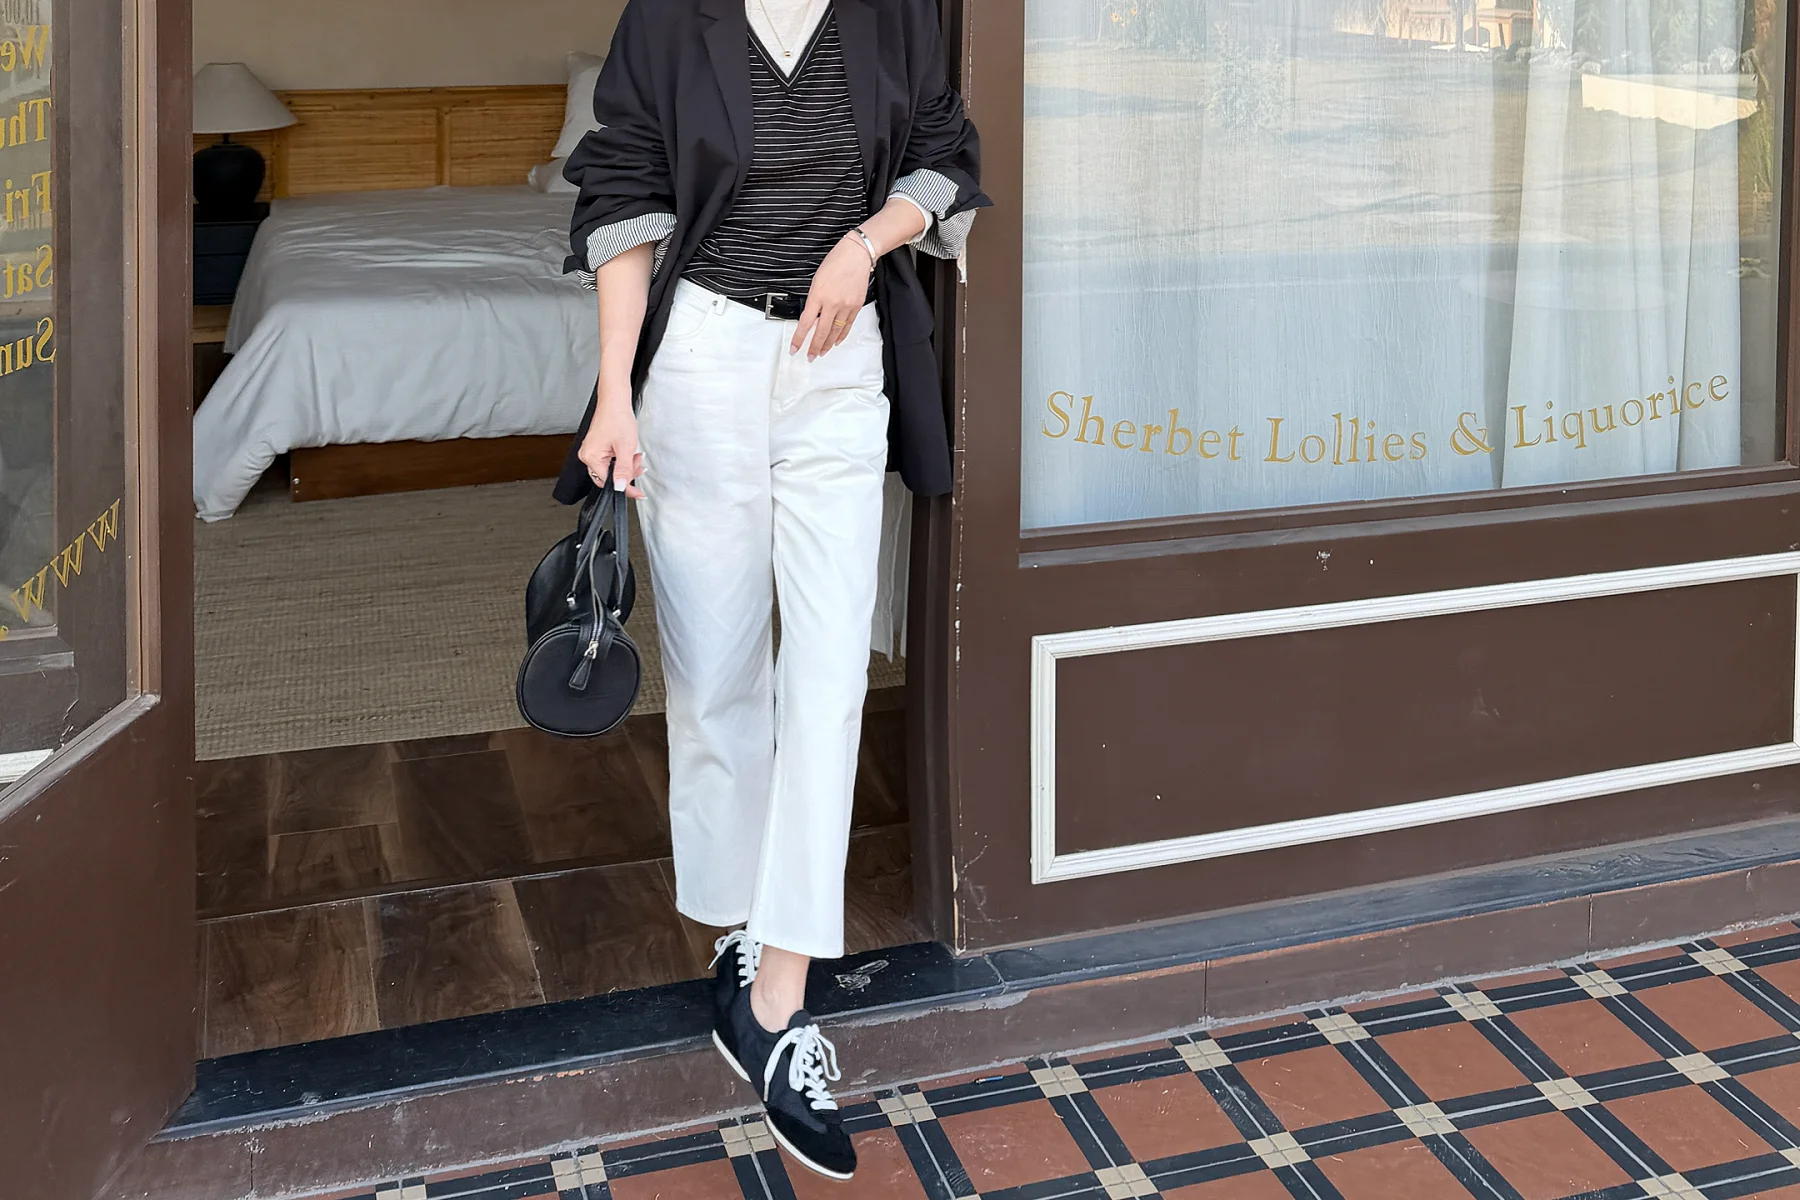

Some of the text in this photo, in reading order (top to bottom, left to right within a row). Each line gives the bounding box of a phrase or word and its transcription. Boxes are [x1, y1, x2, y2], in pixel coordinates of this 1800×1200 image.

[1041, 373, 1730, 466] Sherbet Lollies & Liquorice
